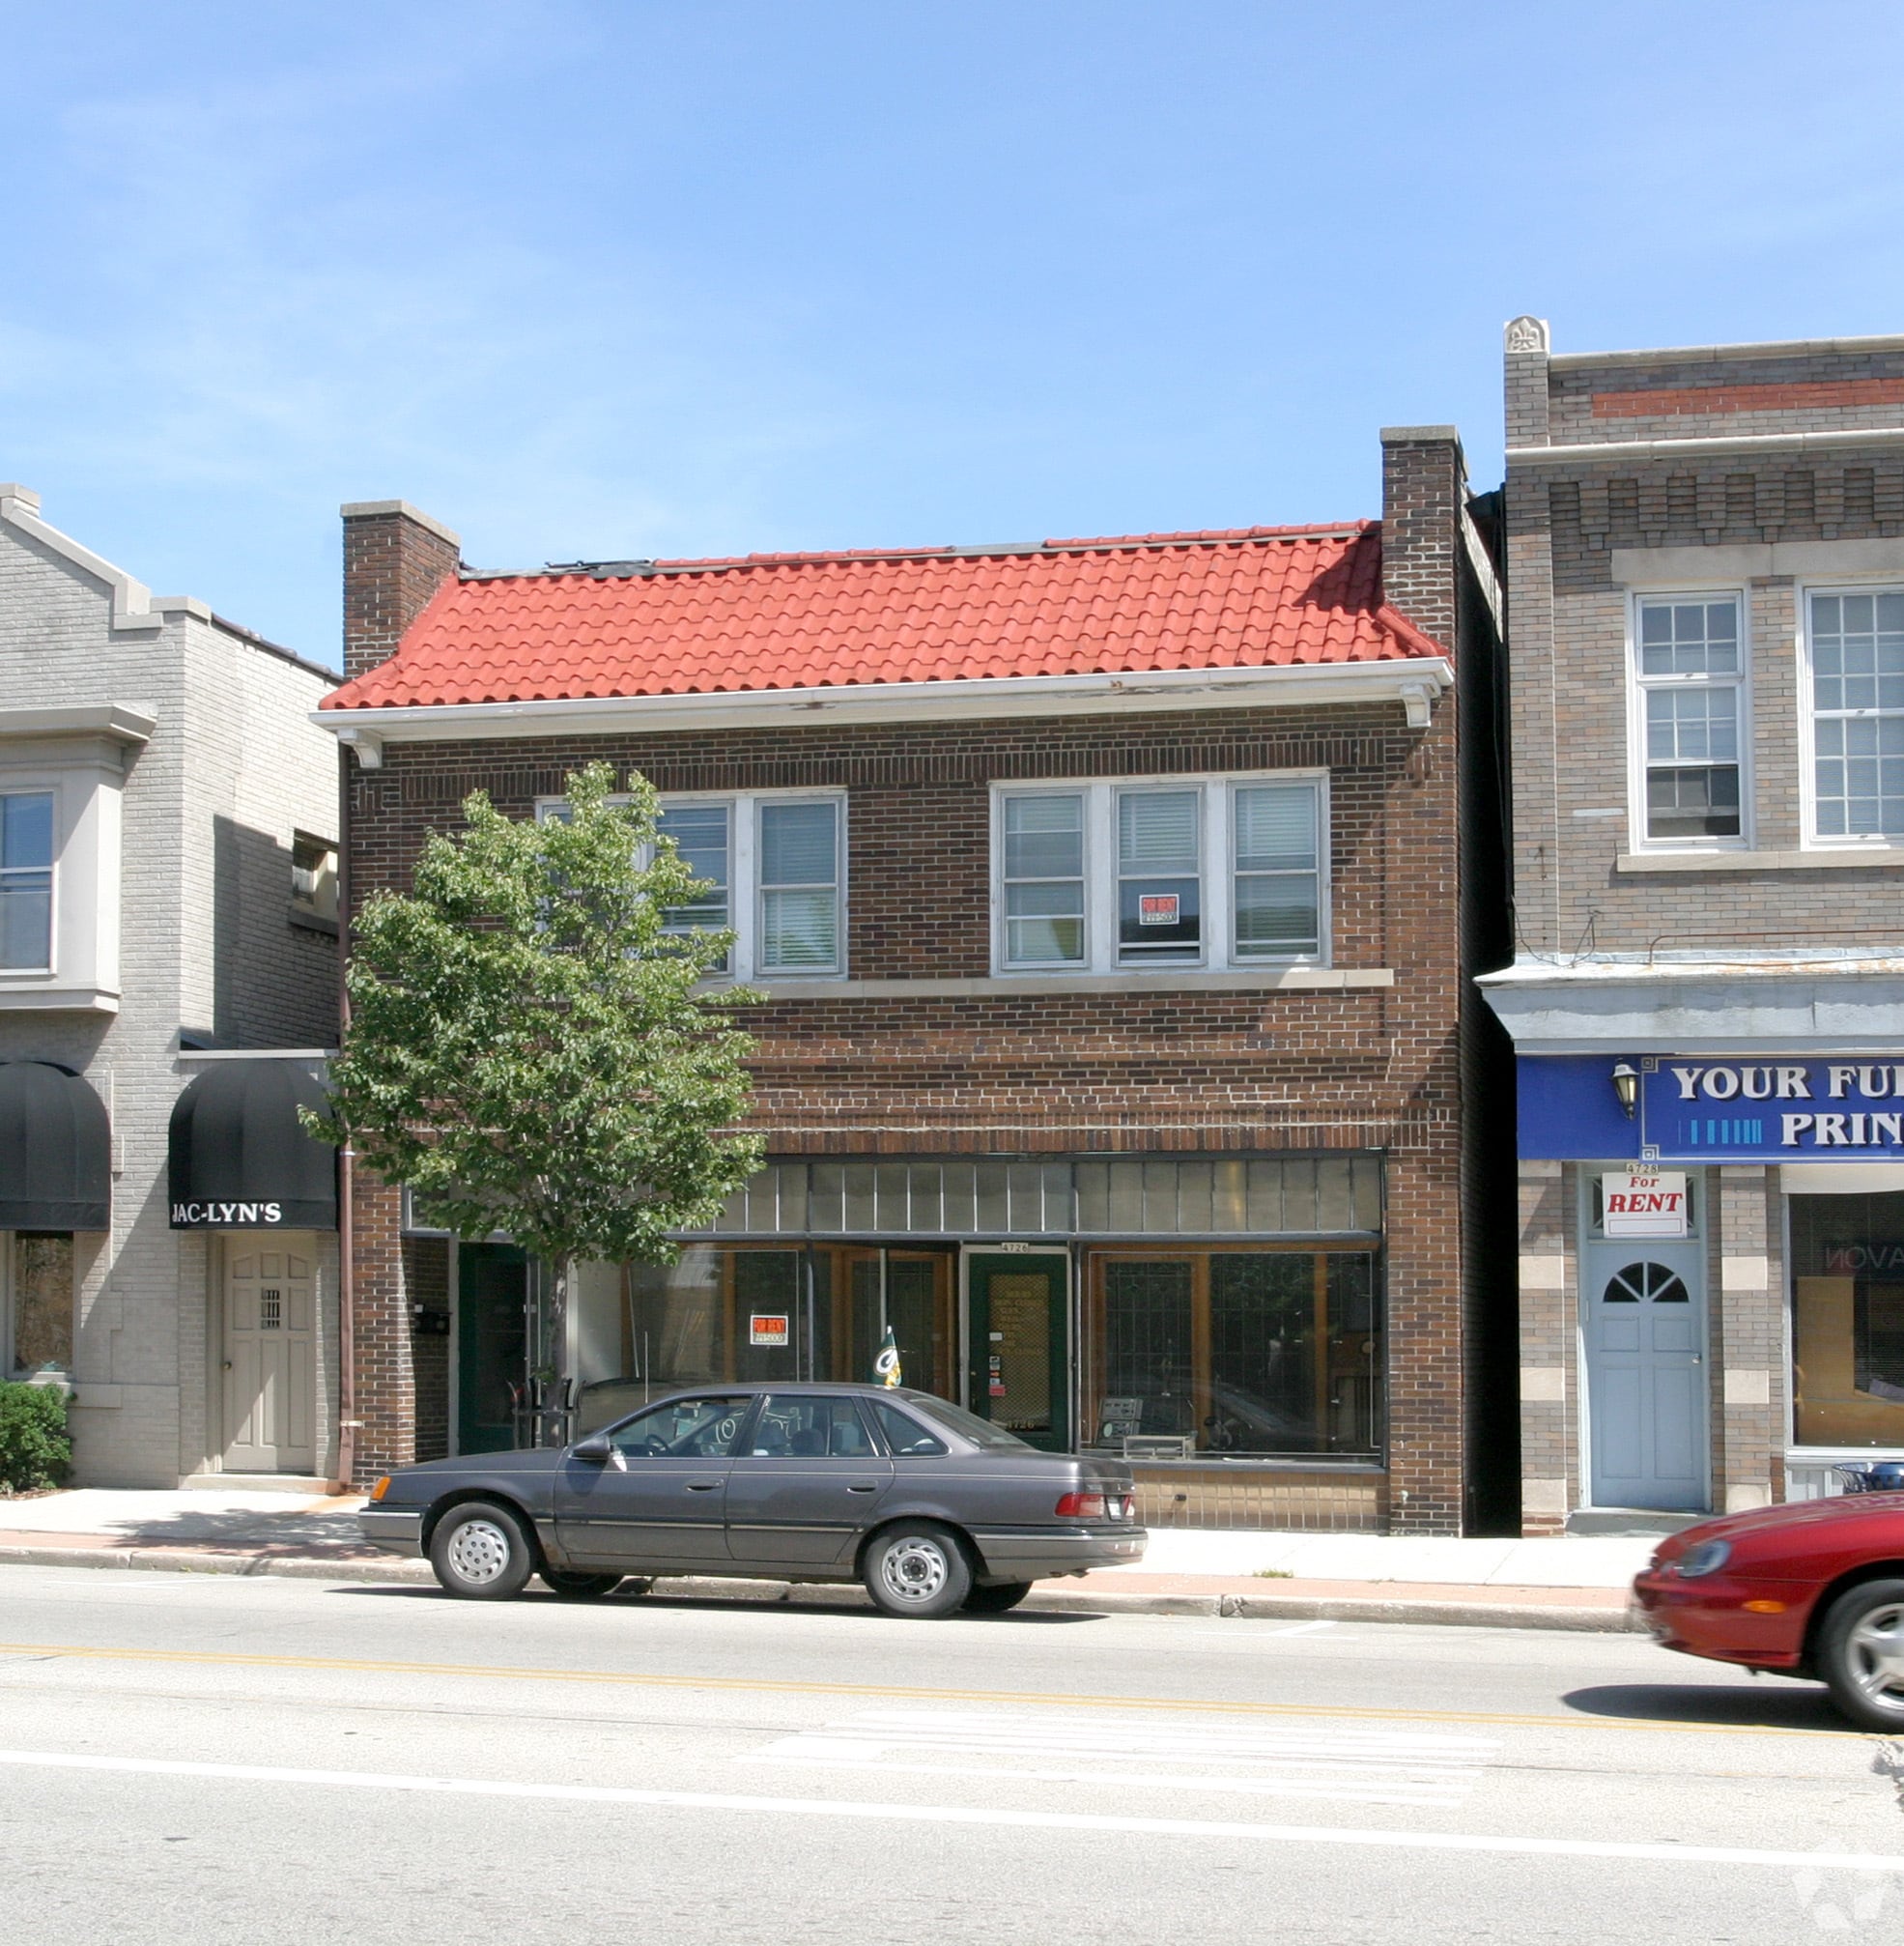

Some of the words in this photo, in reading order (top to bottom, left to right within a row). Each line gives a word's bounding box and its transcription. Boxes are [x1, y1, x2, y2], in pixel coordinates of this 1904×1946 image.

[1671, 1066, 1812, 1100] YOUR
[1781, 1112, 1904, 1145] PRIN
[1628, 1163, 1658, 1173] 4728
[1629, 1176, 1660, 1188] For
[172, 1202, 282, 1223] JAC-LYN'S
[1607, 1192, 1684, 1213] RENT
[1002, 1243, 1028, 1252] 4726
